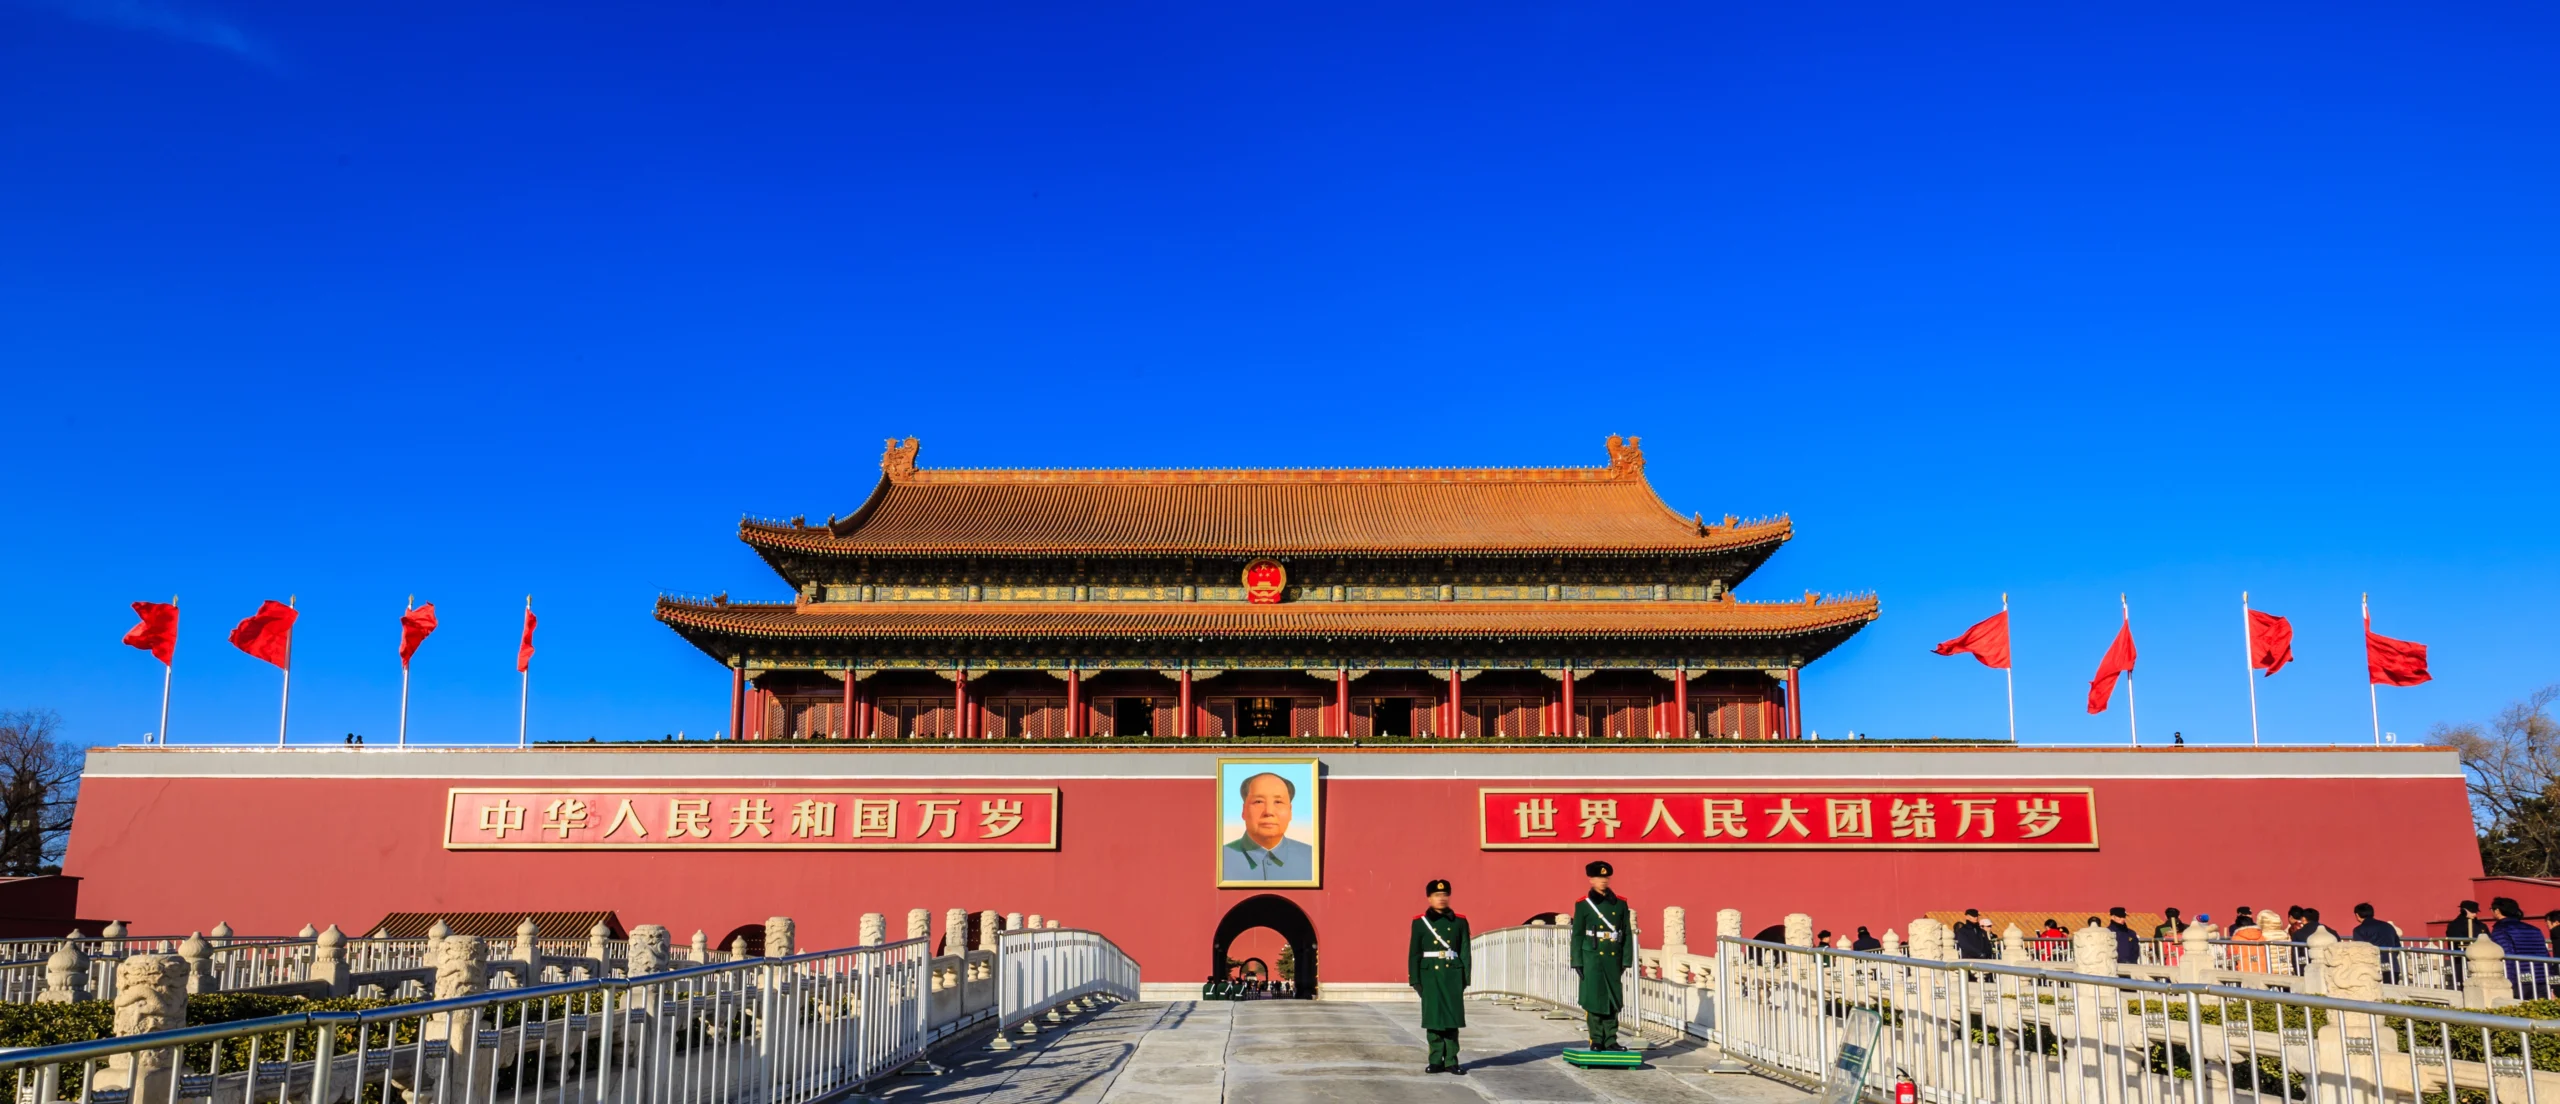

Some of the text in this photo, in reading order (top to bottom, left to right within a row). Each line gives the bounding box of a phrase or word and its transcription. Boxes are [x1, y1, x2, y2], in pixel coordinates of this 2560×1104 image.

[479, 799, 1024, 839] 中华人民共和国万岁
[1515, 799, 2062, 839] 世界人民大团结万岁
